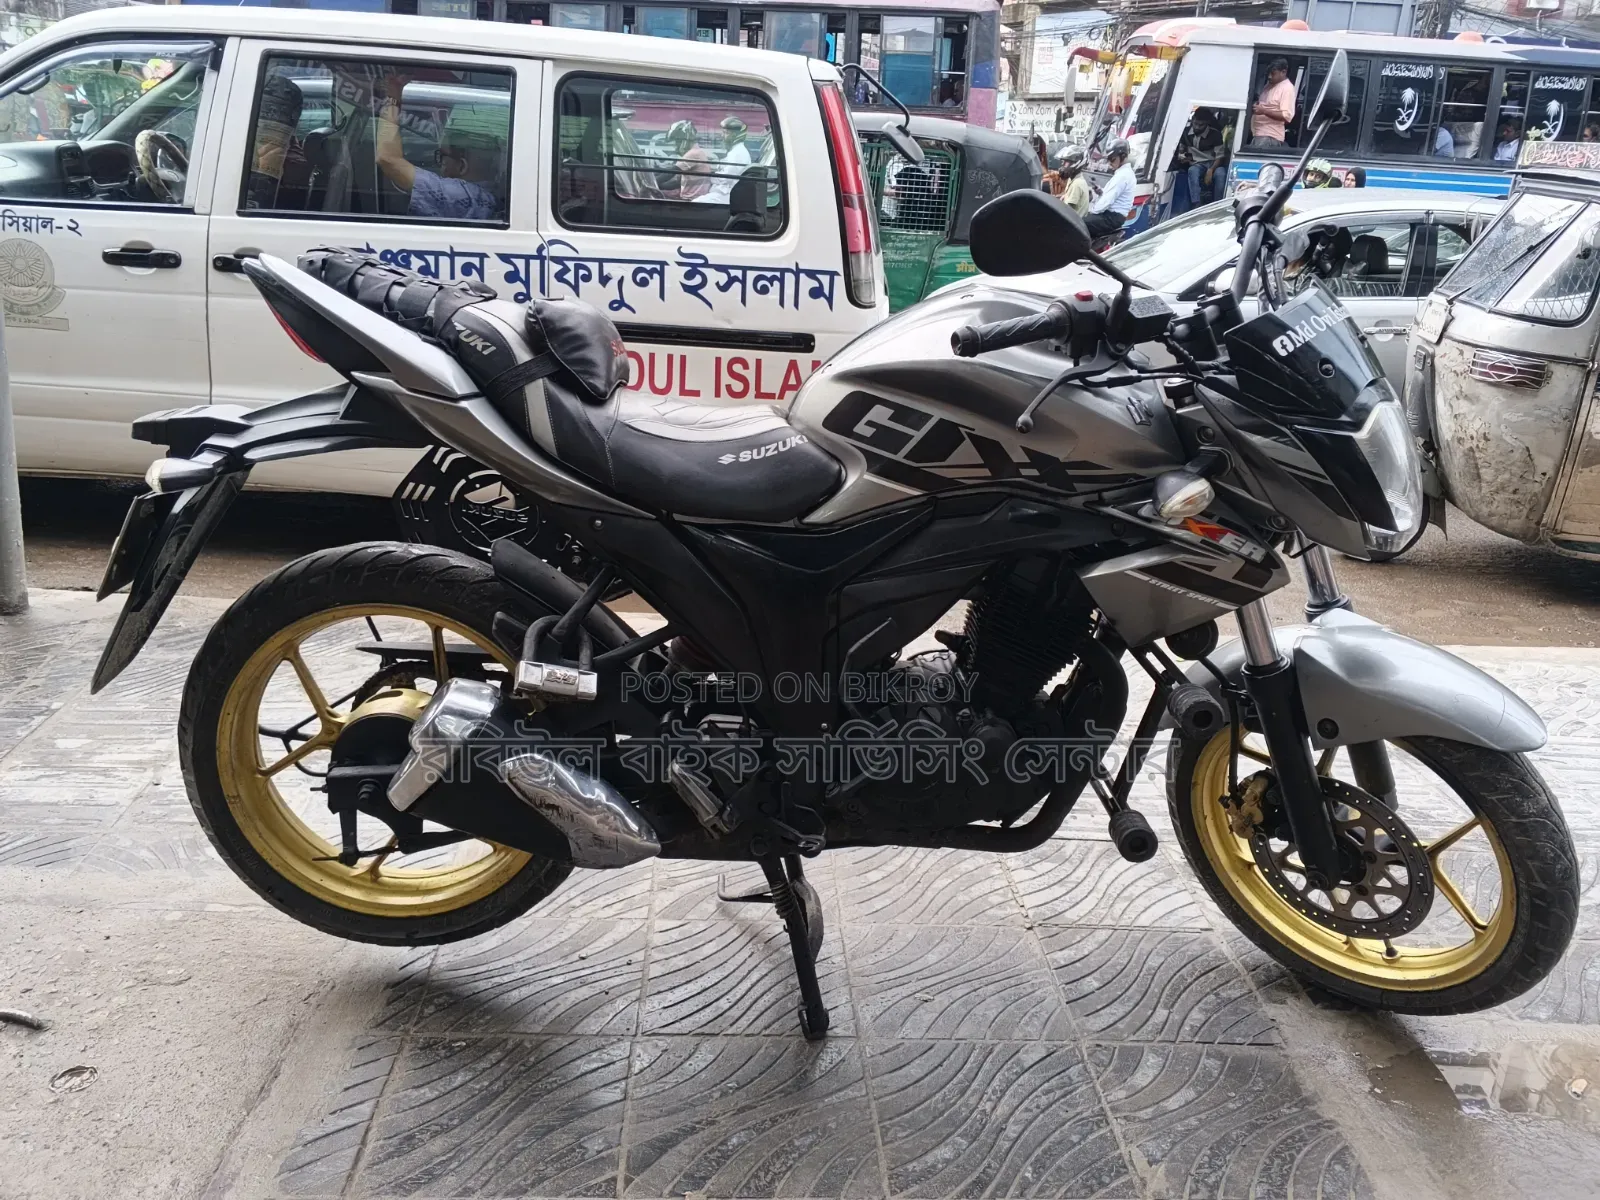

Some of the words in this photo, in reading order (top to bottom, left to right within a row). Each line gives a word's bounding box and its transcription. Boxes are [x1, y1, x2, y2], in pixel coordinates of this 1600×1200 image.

[0, 208, 82, 237] সিয়াল-২
[494, 238, 671, 315] মুফিদুল
[674, 245, 841, 312] ইসলাম
[1286, 319, 1317, 348] Md
[624, 350, 701, 398] DUL
[713, 355, 823, 401] ISLA
[738, 433, 809, 463] SUZUKI
[1148, 578, 1188, 595] STREET
[1186, 591, 1221, 606] SPORT
